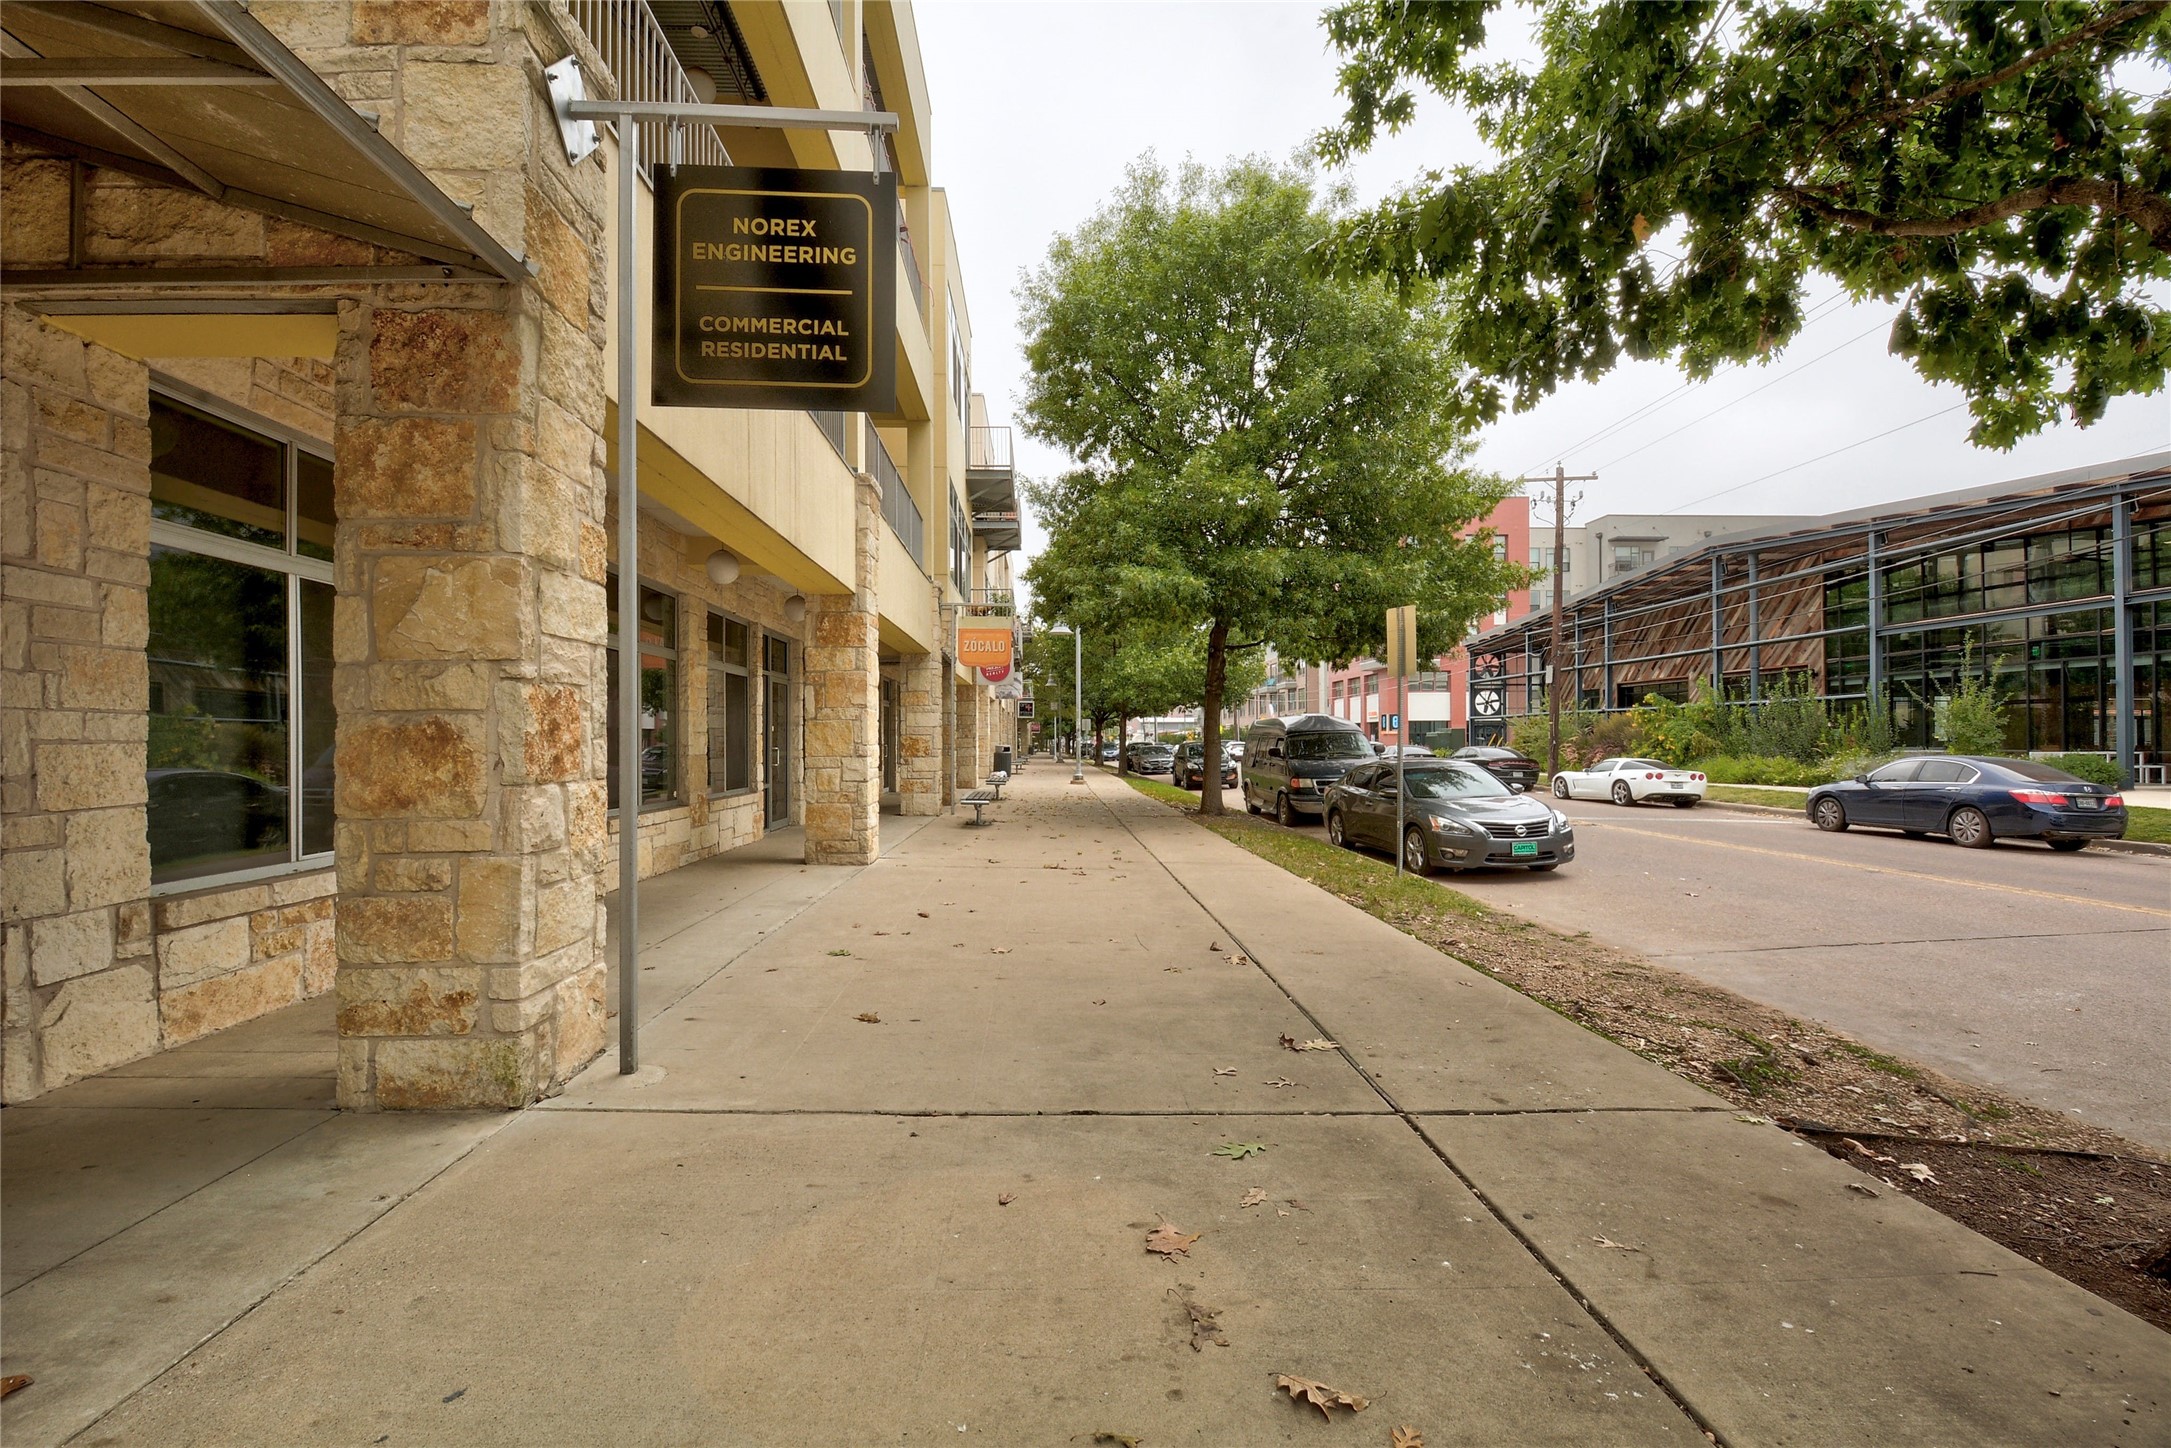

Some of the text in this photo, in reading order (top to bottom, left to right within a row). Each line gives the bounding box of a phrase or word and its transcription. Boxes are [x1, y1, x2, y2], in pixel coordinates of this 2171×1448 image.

[733, 217, 817, 237] NOREX
[692, 242, 857, 265] ENGINEERING
[699, 315, 850, 336] COMMERCIAL
[701, 340, 848, 361] RESIDENTIAL
[964, 637, 1005, 652] ZÓCALO
